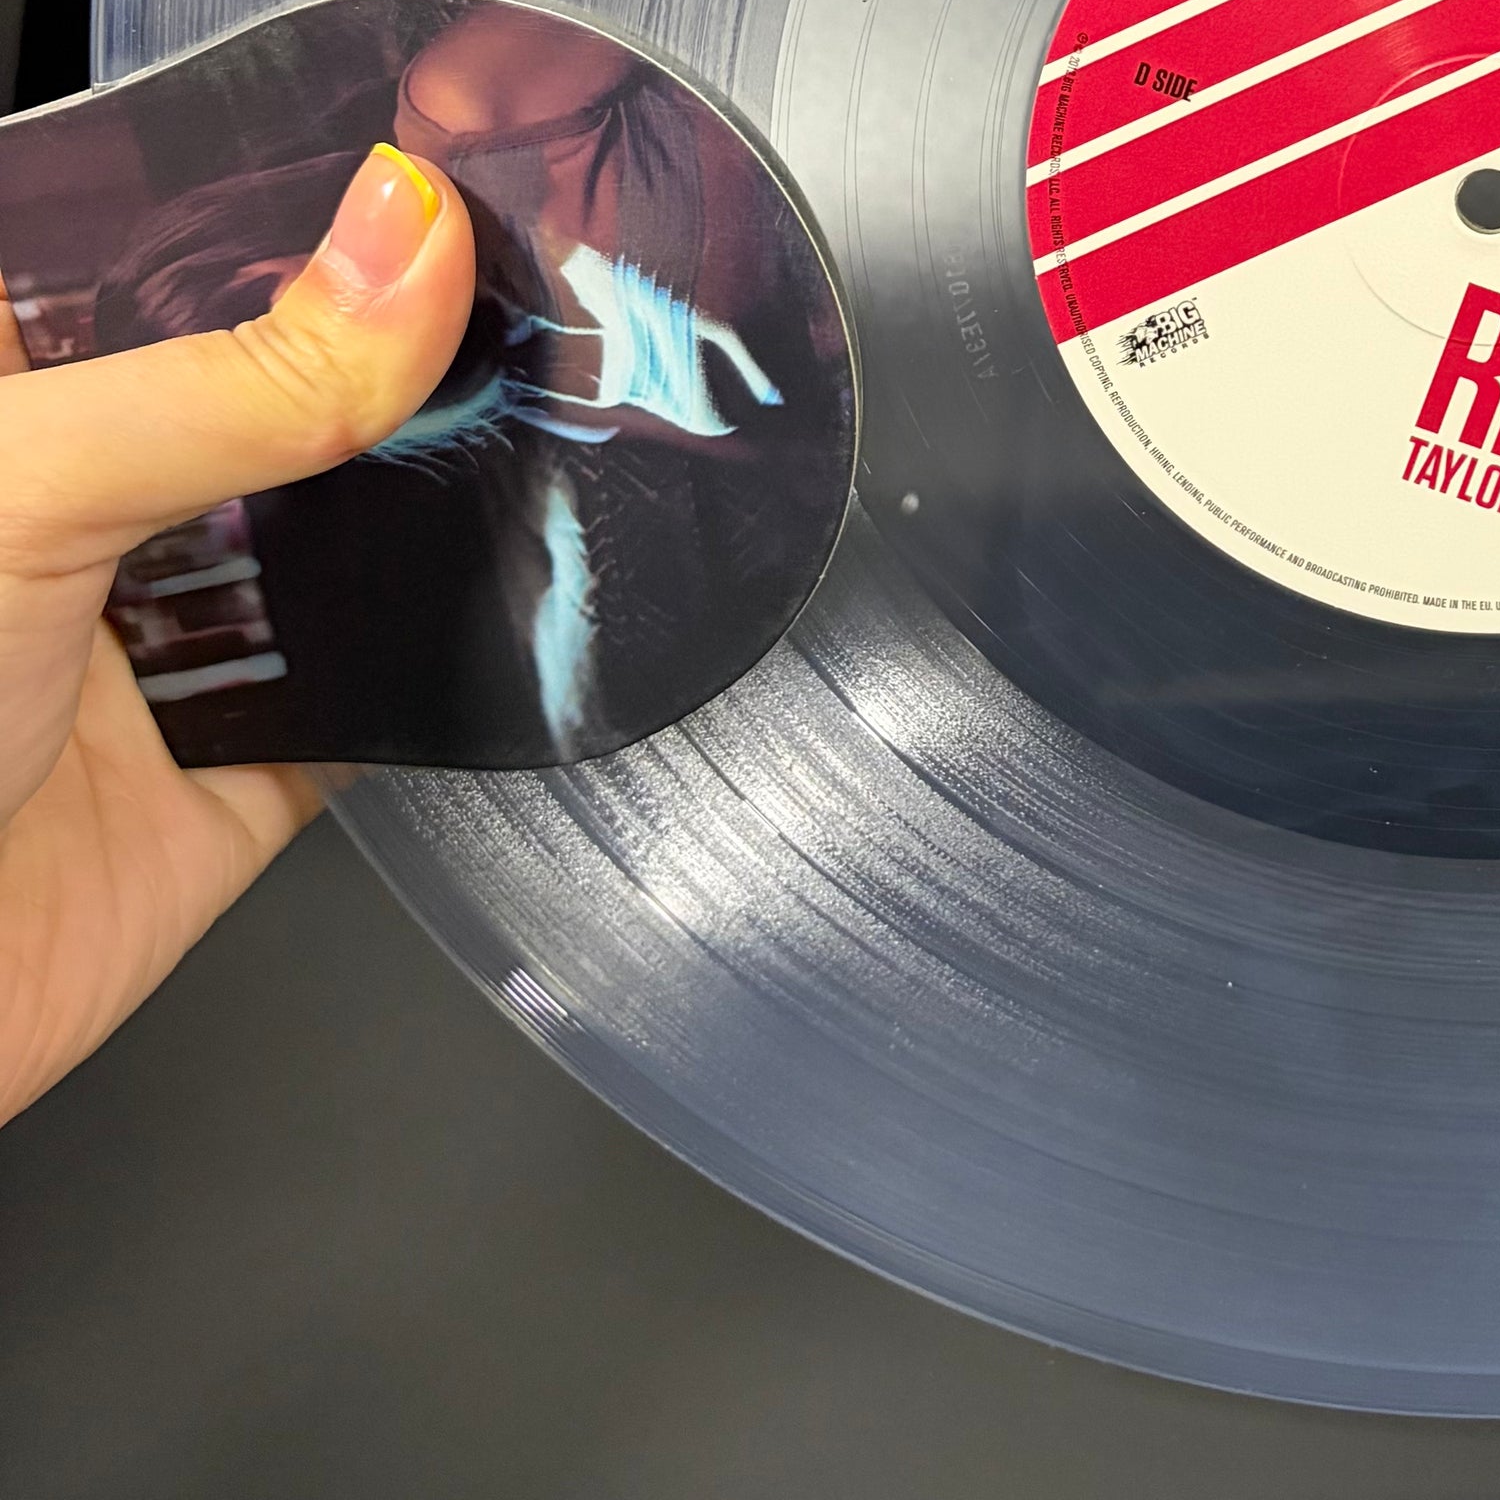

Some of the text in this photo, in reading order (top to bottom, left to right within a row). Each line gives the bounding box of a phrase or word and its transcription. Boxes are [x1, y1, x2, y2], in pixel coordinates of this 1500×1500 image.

[1061, 76, 1074, 93] BIG
[1134, 61, 1198, 102] D SIDE
[1053, 94, 1070, 133] MACHINE
[1049, 134, 1063, 176] RECORDS,
[1049, 197, 1061, 213] ALL
[1051, 215, 1065, 246] RIGHTS
[1055, 247, 1073, 293] RESERVED.
[1065, 293, 1096, 355] UNAUTHORISED
[1154, 300, 1202, 335] BIG
[1134, 319, 1208, 363] MACHINE
[1139, 332, 1210, 368] RECORDS
[1089, 355, 1114, 392] COPYING,
[1109, 391, 1152, 450] REPRODUCTION,
[1149, 446, 1175, 476] HIRING,
[1172, 471, 1205, 504] LENDING,
[1203, 499, 1232, 525] PUBLIC
[1230, 519, 1288, 559] PERFORMANCE
[1286, 553, 1305, 568] AND
[1304, 561, 1367, 592] BROADCASTING
[1368, 584, 1420, 605] PROHIBITED.
[1422, 596, 1447, 609] MADE
[1449, 599, 1459, 609] IN
[1461, 599, 1477, 611] THE
[1479, 600, 1493, 611] EU.
